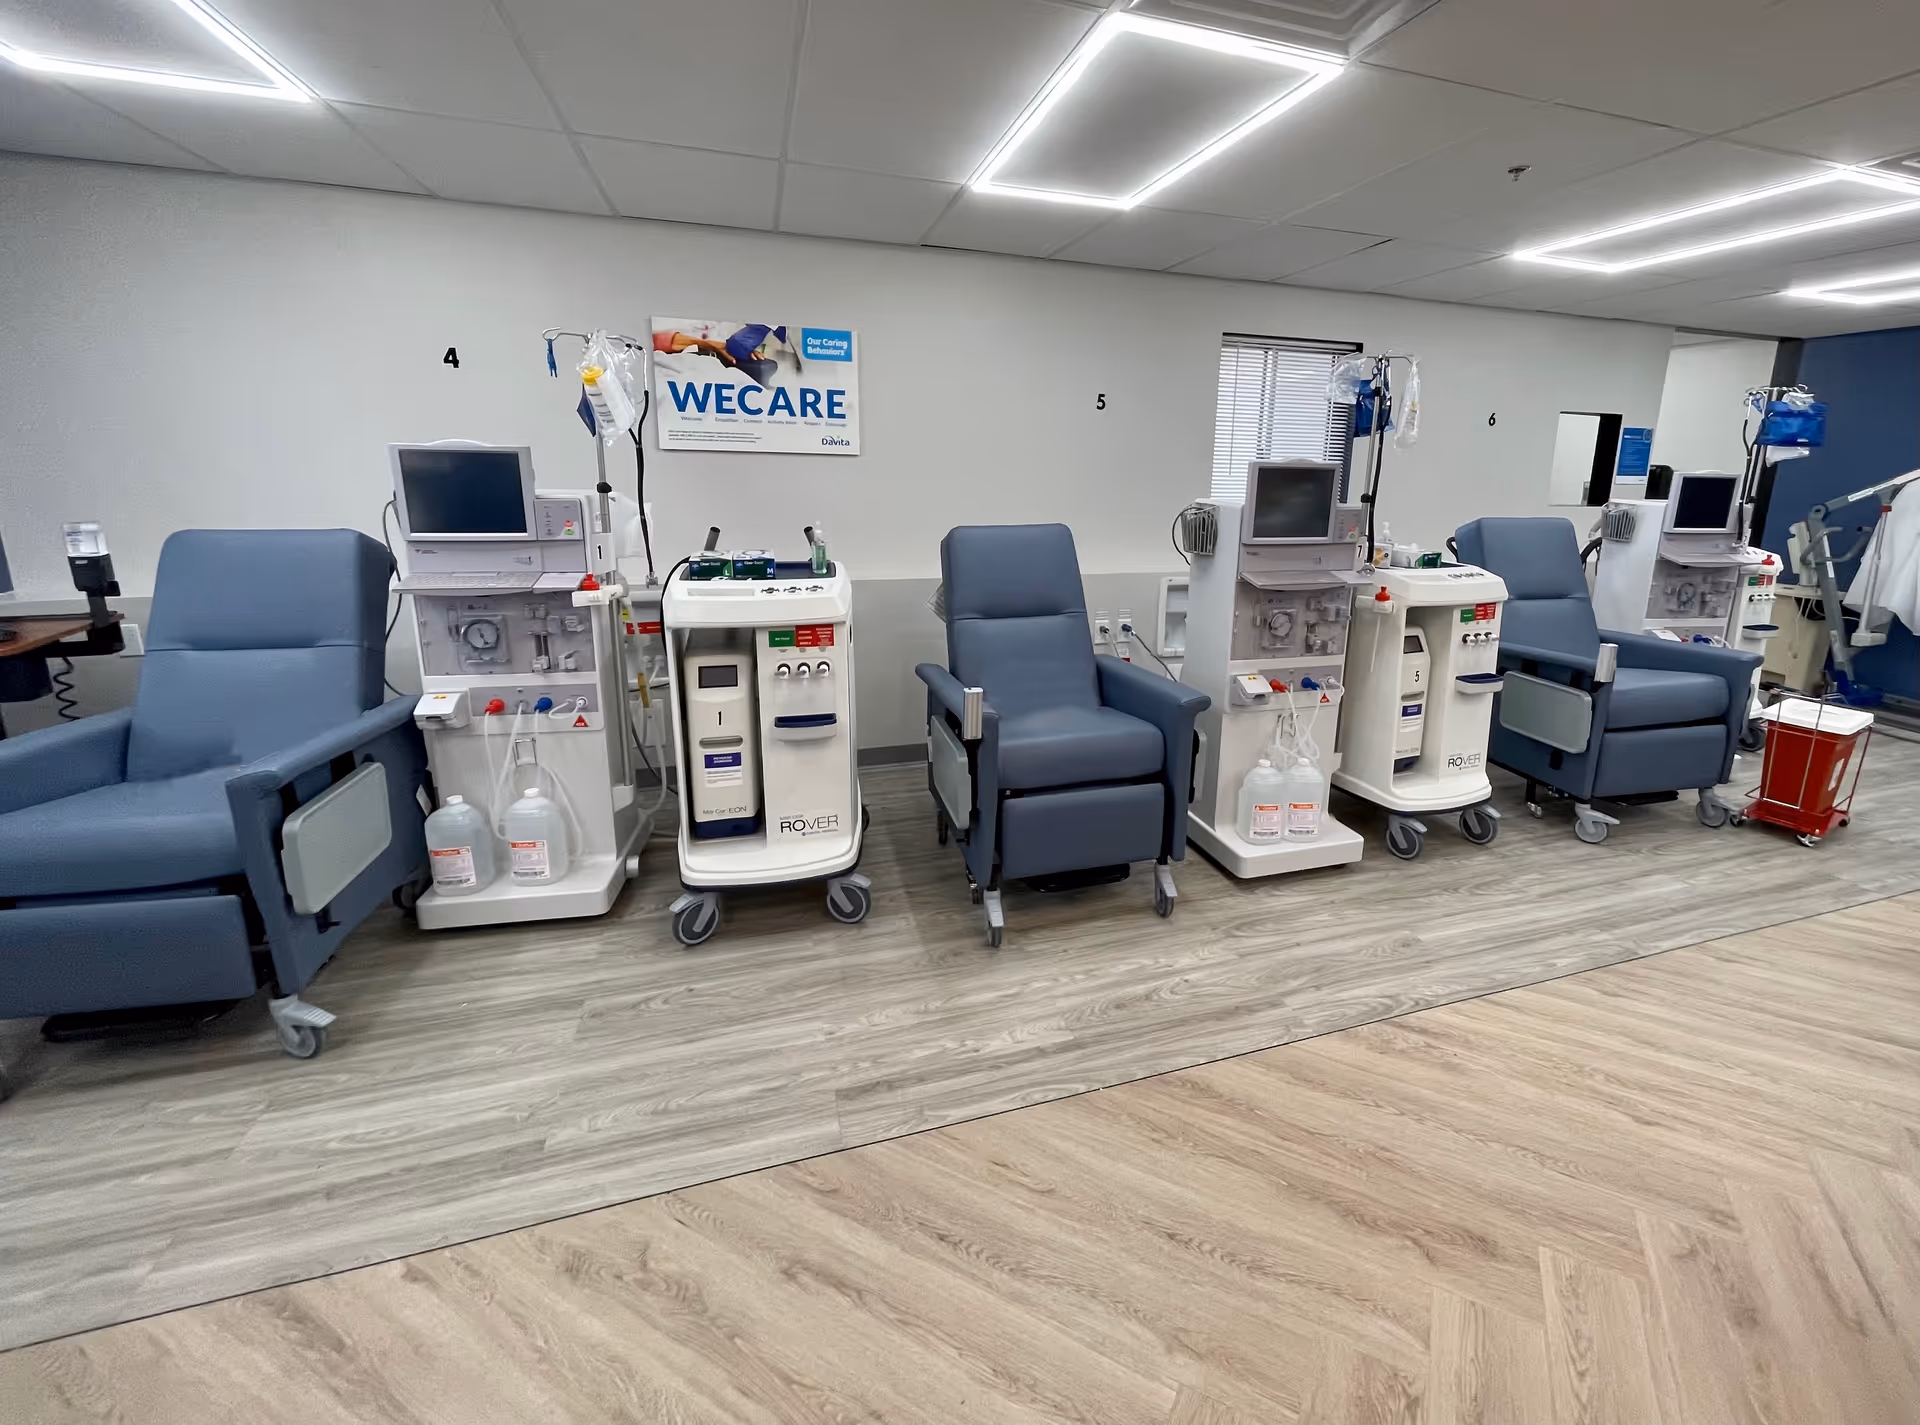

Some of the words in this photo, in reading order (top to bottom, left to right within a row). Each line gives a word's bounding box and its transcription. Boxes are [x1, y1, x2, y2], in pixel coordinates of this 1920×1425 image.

[807, 337, 821, 345] Our
[822, 338, 848, 349] Caring
[443, 347, 459, 368] 4
[807, 346, 845, 356] Behaviors
[667, 381, 846, 419] WECARE
[1096, 393, 1106, 410] 5
[1488, 412, 1496, 426] 6
[597, 545, 602, 560] 1
[1358, 545, 1363, 558] 7
[1414, 670, 1420, 683] 5
[717, 711, 722, 726] 1
[1448, 753, 1481, 768] ROVER
[728, 806, 747, 814] EON
[780, 814, 839, 833] ROVER
